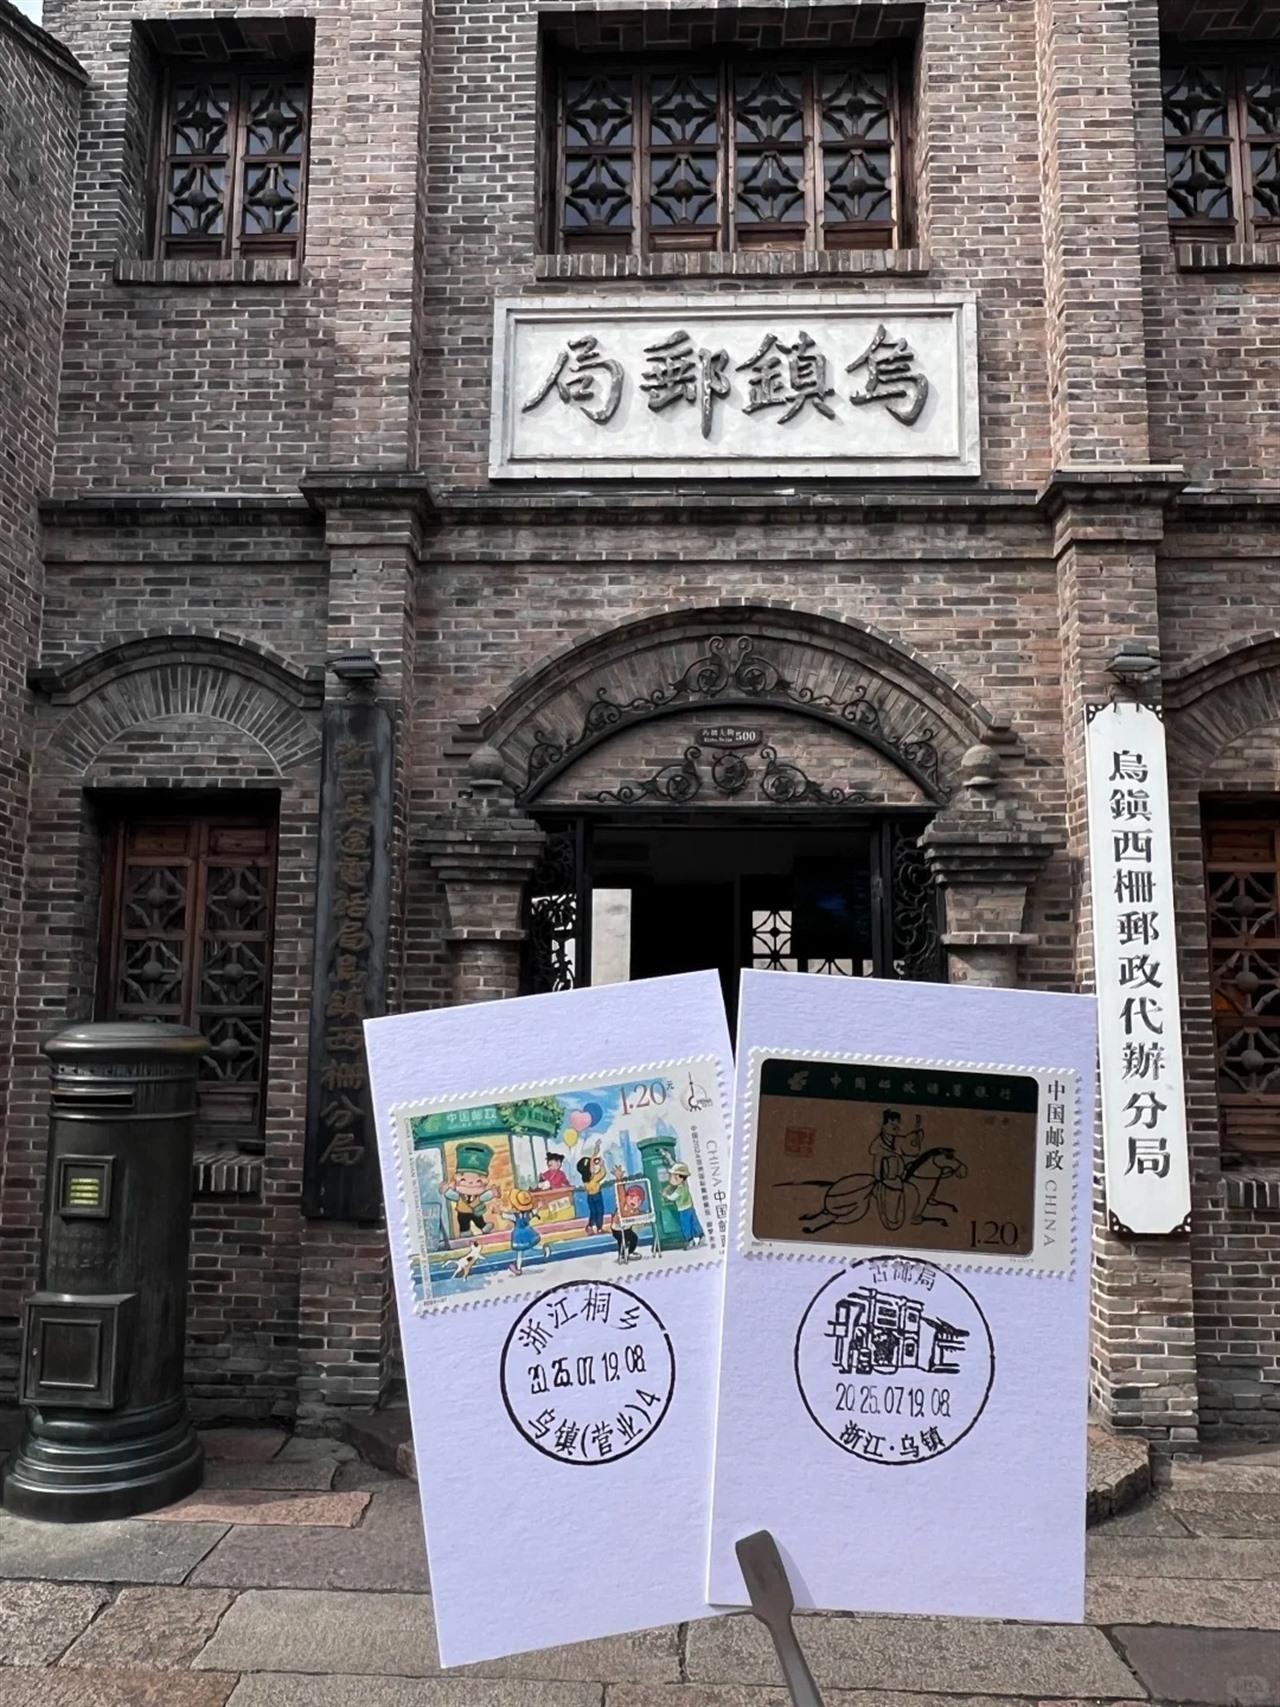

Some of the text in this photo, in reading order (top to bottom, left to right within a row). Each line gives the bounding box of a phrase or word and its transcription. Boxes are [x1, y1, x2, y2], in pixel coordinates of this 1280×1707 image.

[735, 731, 756, 741] 500
[1045, 1080, 1066, 1170] 中国邮政
[706, 1139, 722, 1187] CHINA
[971, 1220, 1018, 1248] 1.20
[1043, 1179, 1058, 1246] CHINA
[518, 1287, 641, 1355] 浙江桐乡
